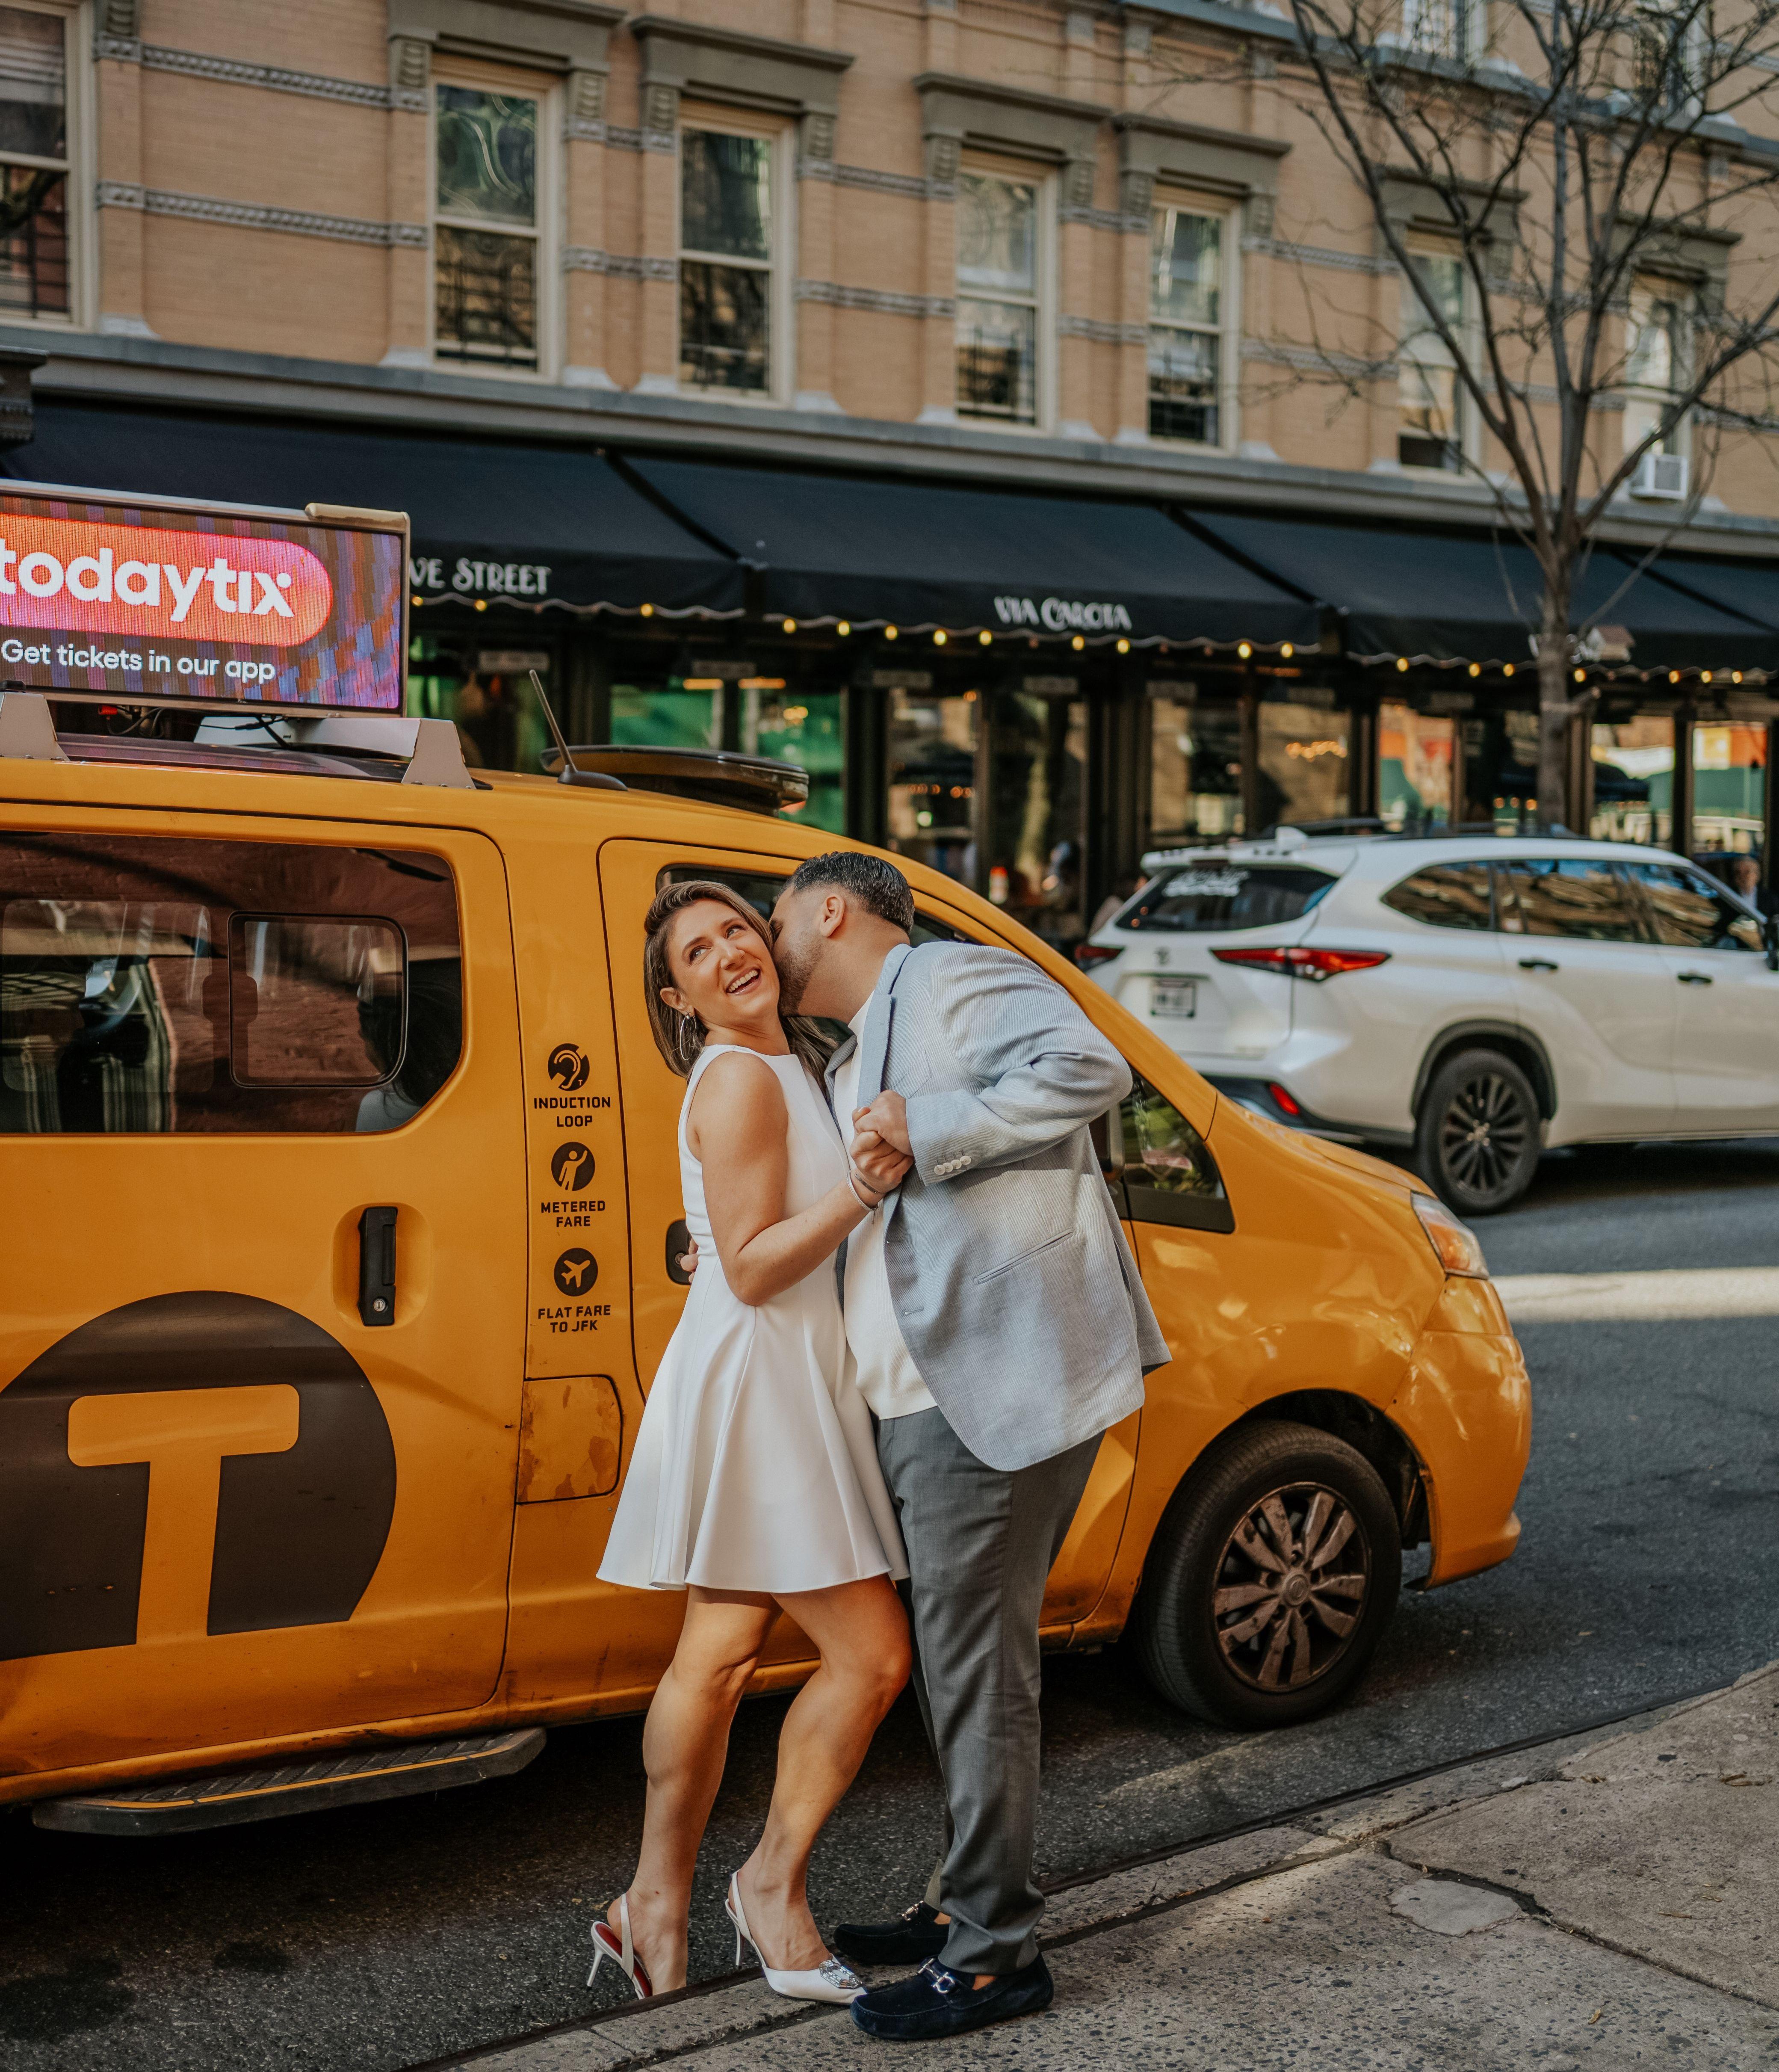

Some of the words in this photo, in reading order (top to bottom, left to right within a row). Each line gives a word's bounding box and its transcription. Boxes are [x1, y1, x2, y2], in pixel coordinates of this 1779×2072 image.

[452, 557, 552, 595] STREET
[993, 596, 1040, 626] VIA
[1040, 597, 1133, 632] CAROTA
[1, 639, 51, 665] Get
[56, 643, 143, 672] tickets
[148, 649, 171, 673] in
[177, 658, 220, 676] our
[225, 660, 276, 684] app
[534, 1096, 611, 1109] INDUCTION
[556, 1115, 593, 1127] LOOP
[541, 1200, 606, 1213] METERED
[556, 1216, 591, 1228] FARE
[538, 1306, 572, 1320] FLAT
[576, 1305, 611, 1317] FARE
[550, 1321, 568, 1333] TO
[571, 1320, 598, 1332] JFK
